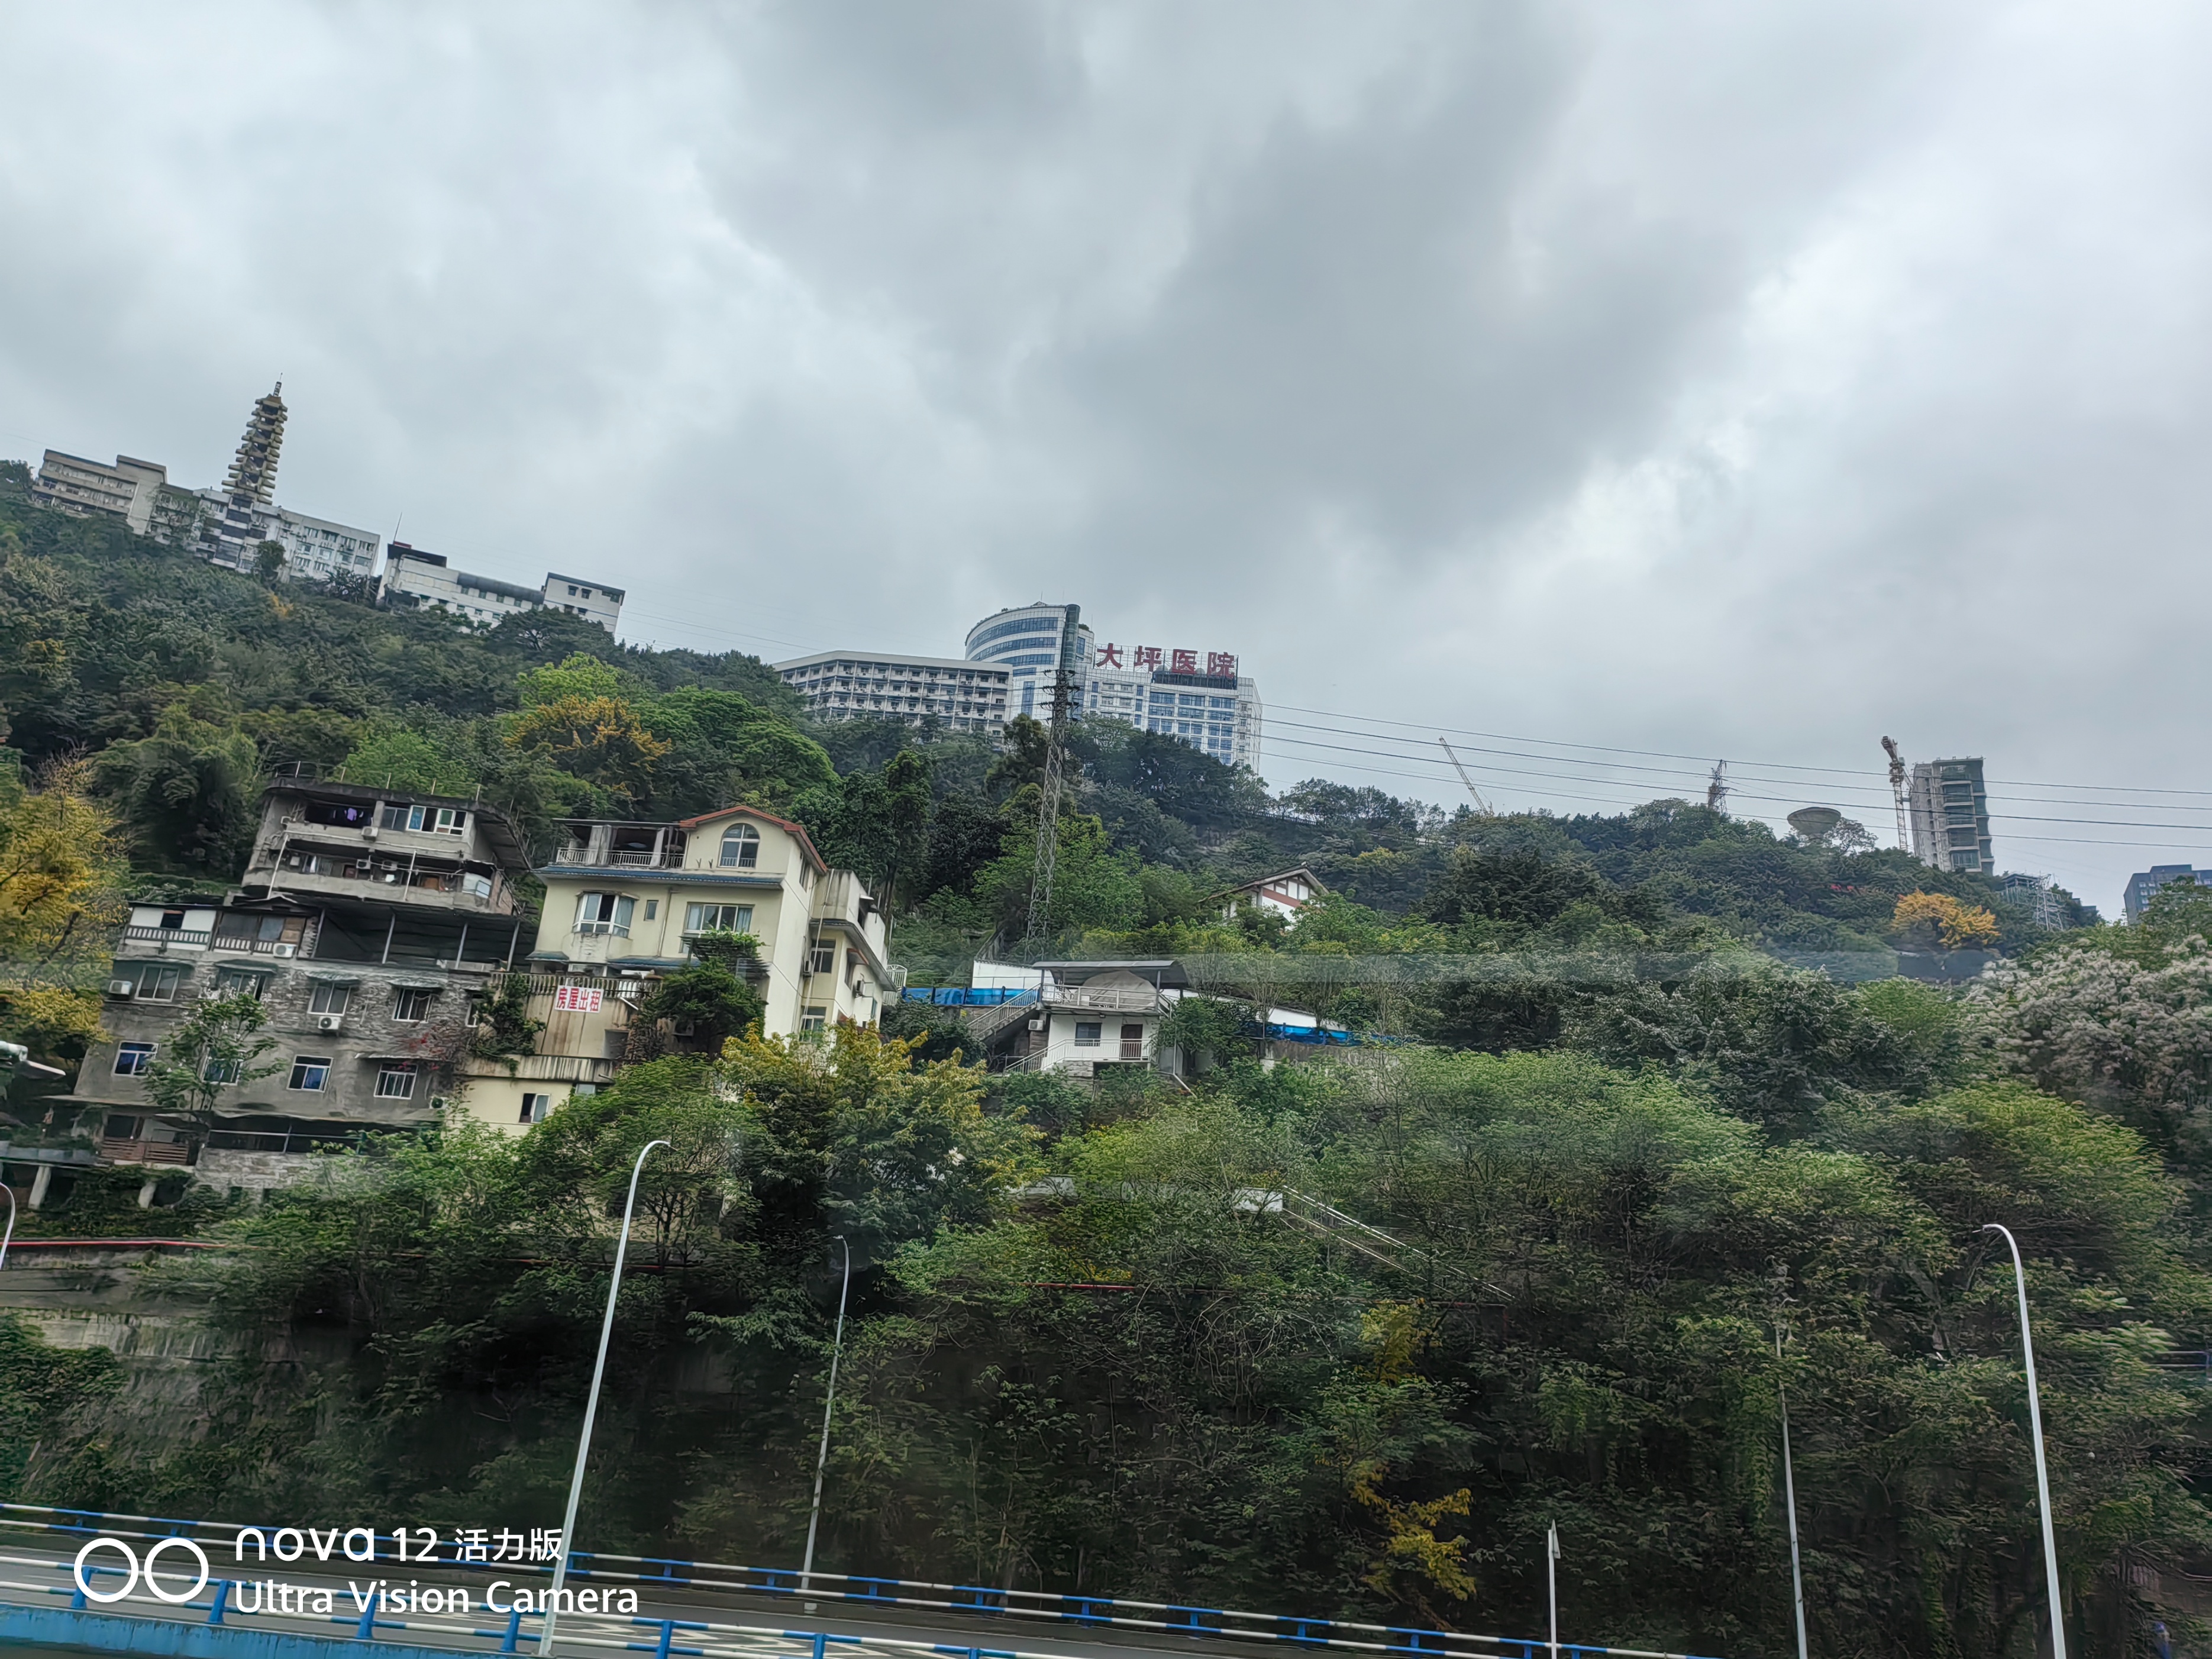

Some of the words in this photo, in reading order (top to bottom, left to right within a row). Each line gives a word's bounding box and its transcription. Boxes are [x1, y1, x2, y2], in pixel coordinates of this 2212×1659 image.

[1096, 643, 1235, 679] 大坪医院
[557, 987, 601, 1011] 房屋出租
